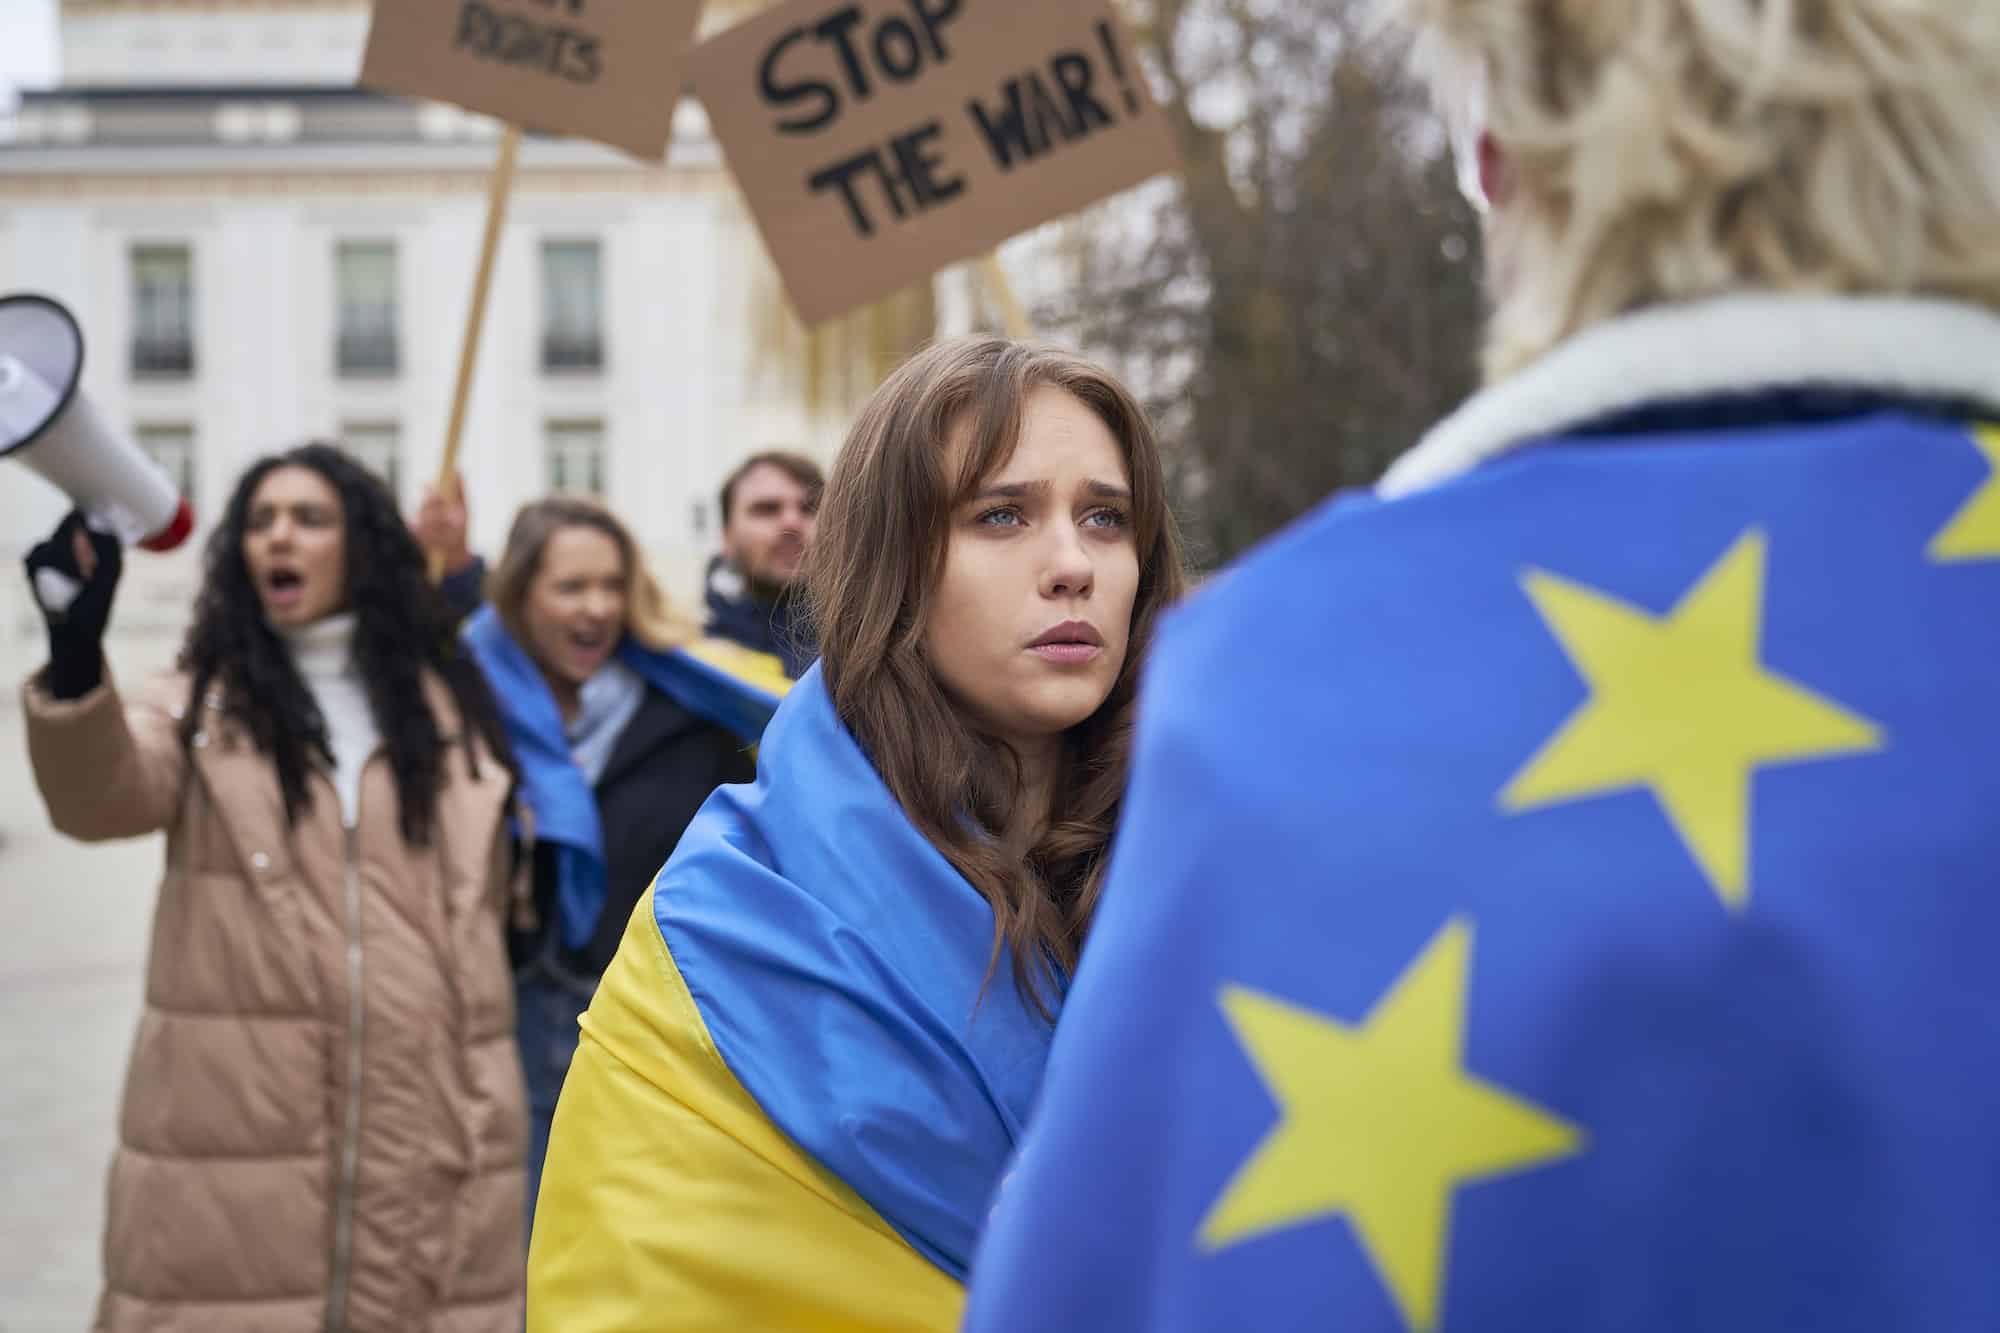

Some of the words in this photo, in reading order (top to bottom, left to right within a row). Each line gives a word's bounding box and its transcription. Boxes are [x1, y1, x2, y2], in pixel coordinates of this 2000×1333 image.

[455, 0, 603, 84] RIGHTS
[808, 121, 966, 239] THE
[967, 20, 1141, 172] WAR!
